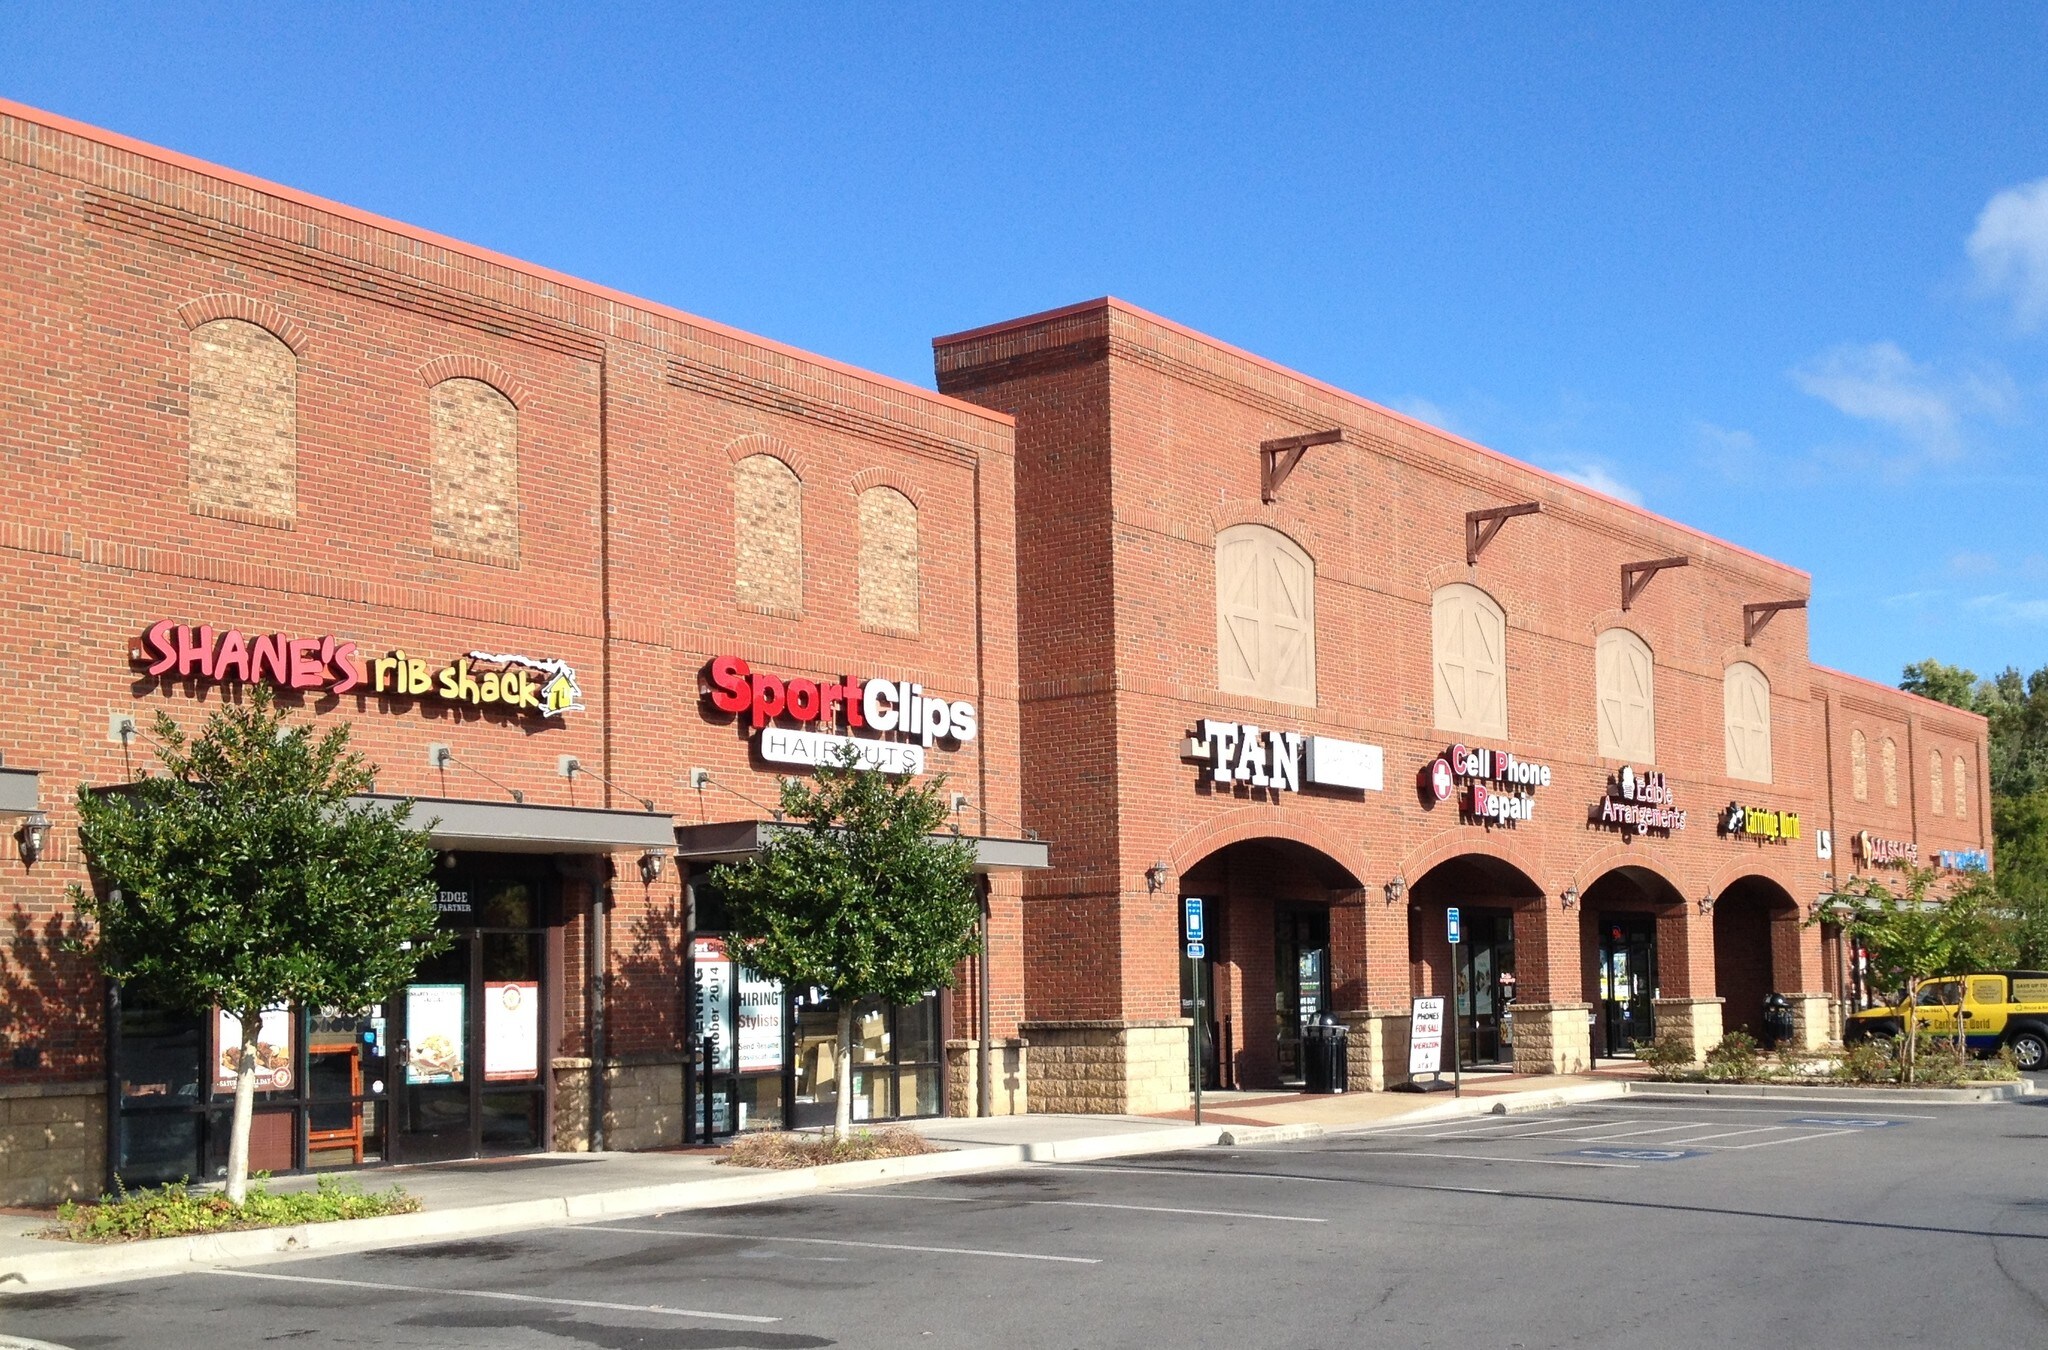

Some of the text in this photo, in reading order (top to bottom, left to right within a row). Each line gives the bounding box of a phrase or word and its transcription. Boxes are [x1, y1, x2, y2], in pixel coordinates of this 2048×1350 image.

[149, 619, 359, 694] SHANE'S
[439, 659, 539, 708] shack
[1204, 719, 1301, 792] TAN
[1452, 744, 1551, 787] Cell Phone
[1474, 784, 1535, 824] Repair
[1636, 770, 1673, 805] Edible
[1602, 795, 1687, 834] Arrangements
[1871, 837, 1918, 867] MASSAGE
[438, 903, 472, 912] PARTNER
[440, 892, 468, 903] EDGE
[710, 967, 719, 1003] 2014
[740, 992, 779, 1006] HIRING
[739, 1014, 779, 1030] Stylists
